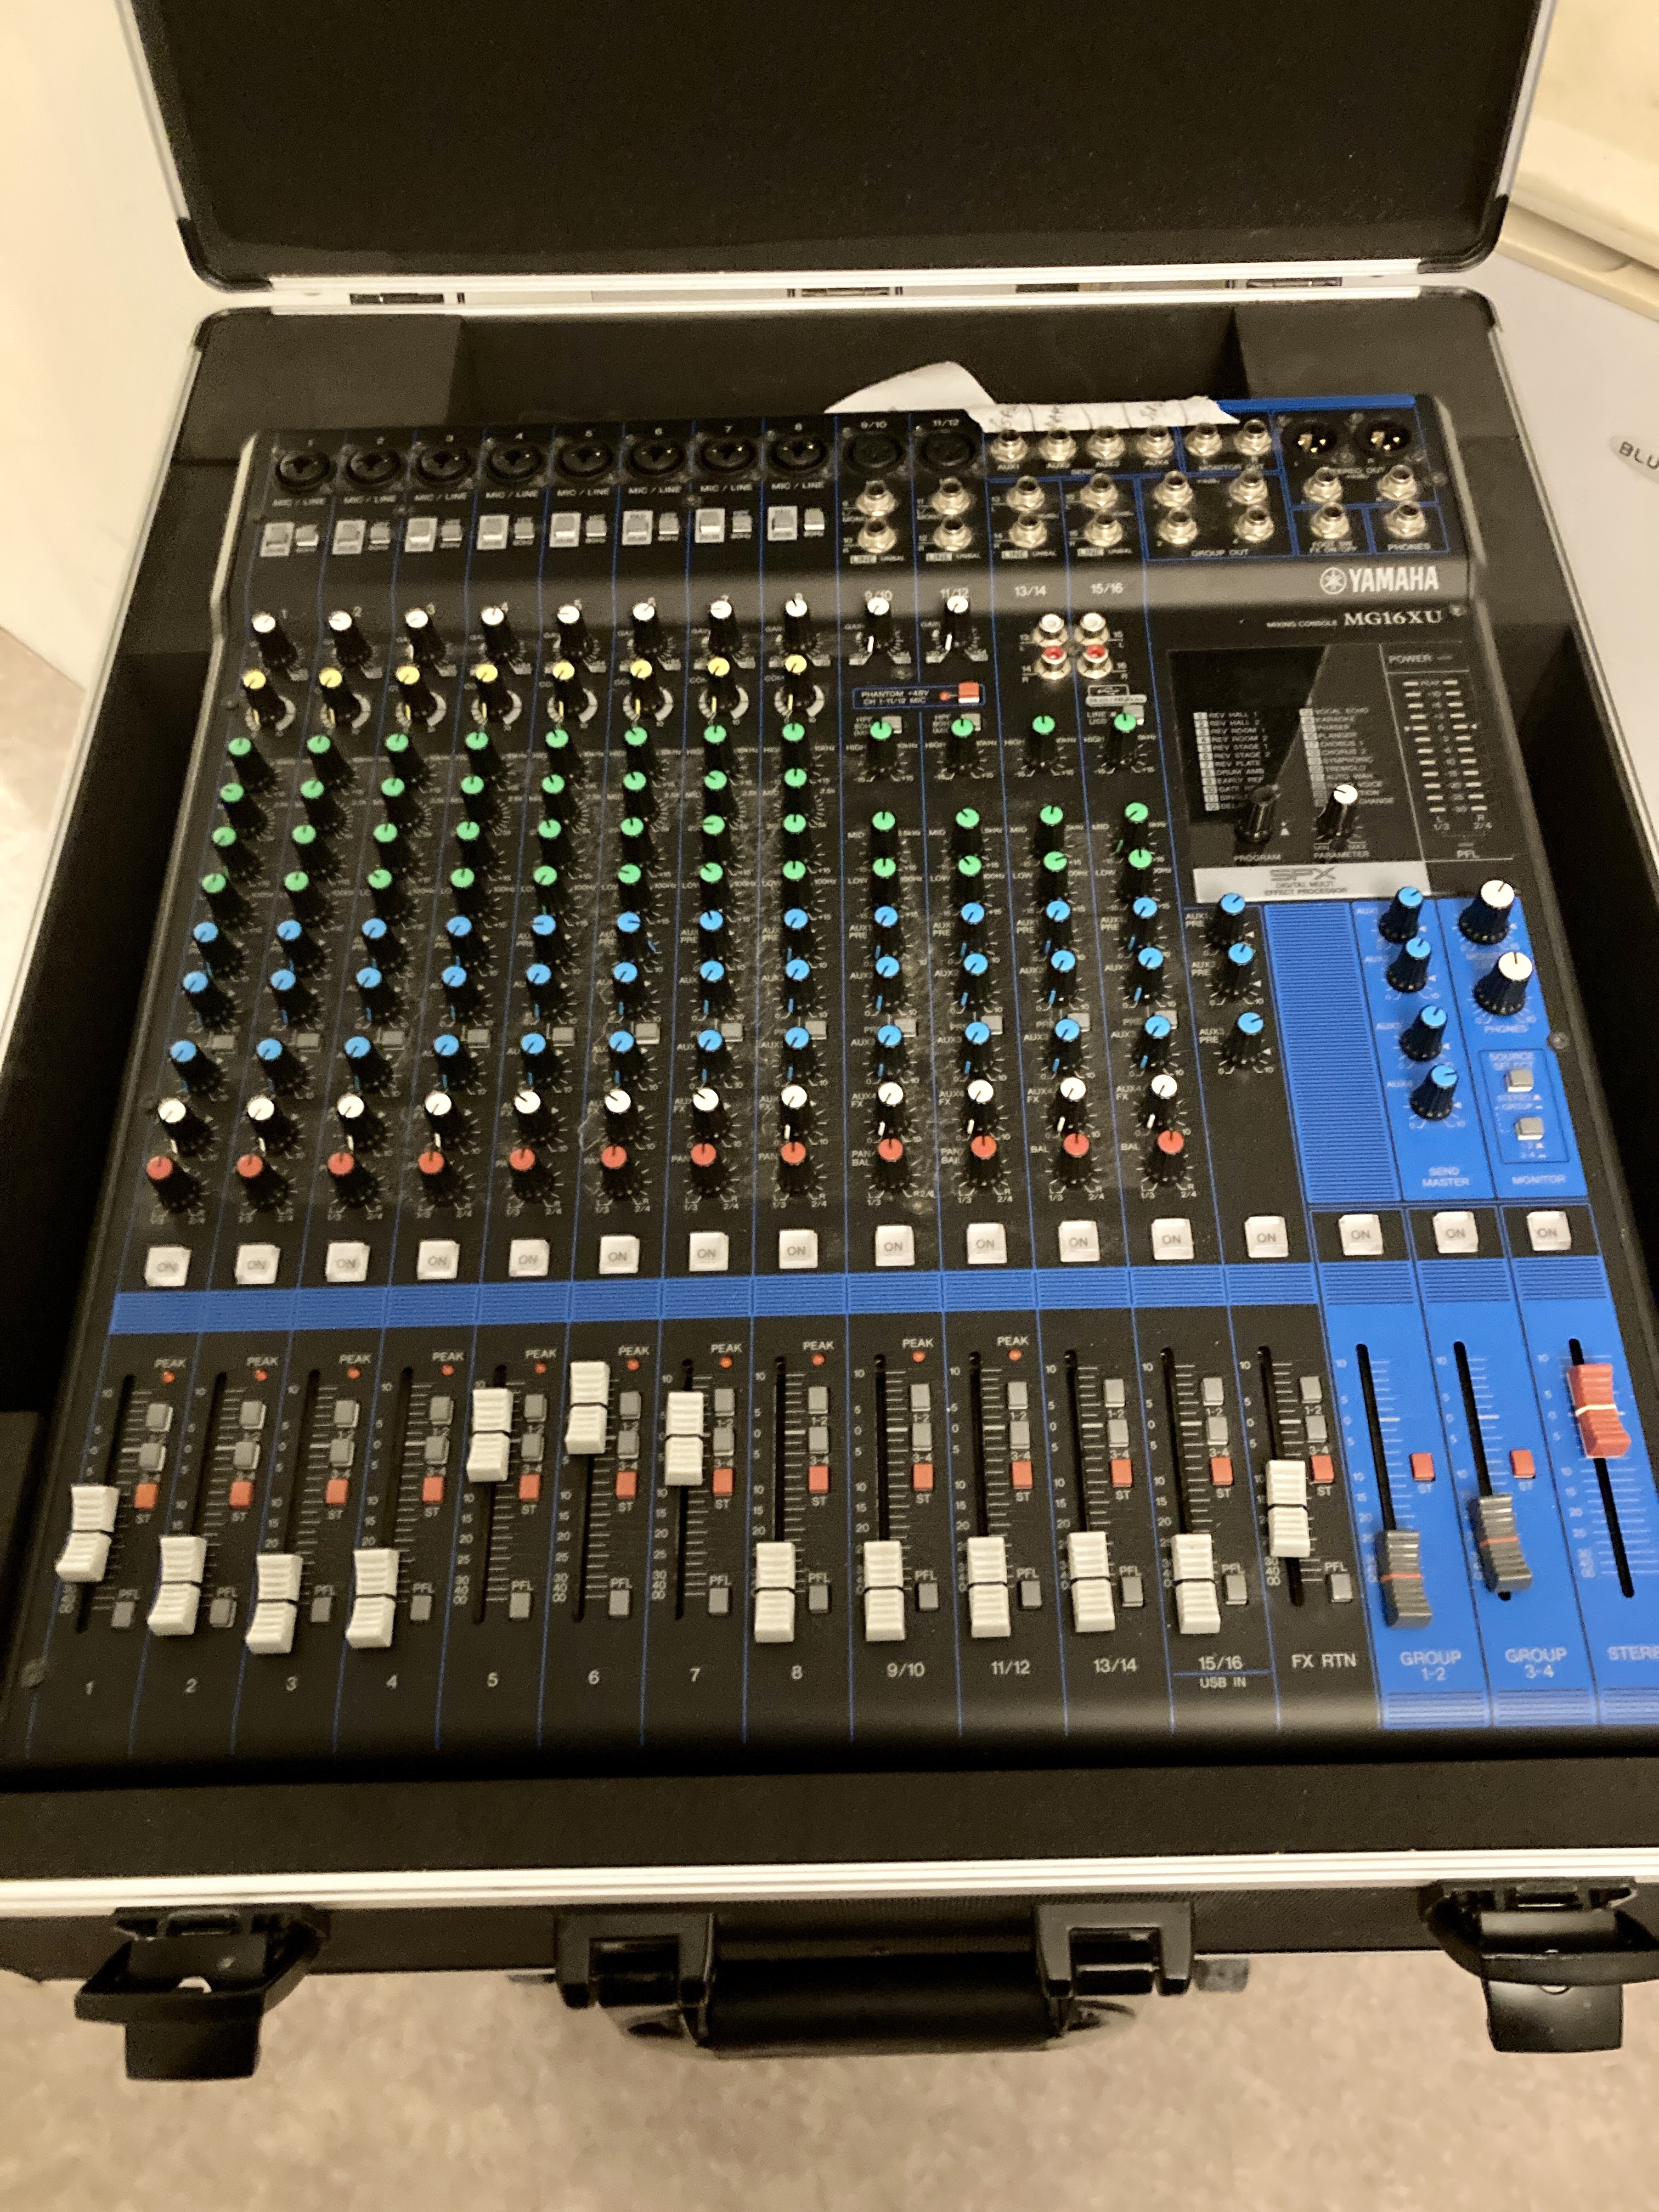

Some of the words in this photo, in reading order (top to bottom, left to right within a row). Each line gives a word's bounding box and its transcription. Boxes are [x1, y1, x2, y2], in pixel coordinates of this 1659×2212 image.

[1349, 566, 1439, 592] YAMAHA
[1015, 585, 1047, 596] 13/14
[1091, 583, 1123, 595] 15/16
[1344, 610, 1442, 625] MG16XU
[1389, 654, 1432, 663] POWER
[1457, 850, 1478, 859] PFL
[1030, 1145, 1049, 1153] BAL
[852, 1159, 870, 1167] BAL
[941, 1156, 960, 1165] BAL
[1429, 1167, 1460, 1176] SEND
[1422, 1177, 1469, 1187] MASTER
[1512, 1175, 1565, 1184] MONITOR
[1256, 1232, 1277, 1243] ON
[1351, 1229, 1371, 1240] ON
[1446, 1228, 1466, 1239] ON
[1537, 1227, 1558, 1238] ON
[976, 1239, 995, 1250] ON
[1069, 1237, 1088, 1248] ON
[1161, 1234, 1182, 1245] ON
[787, 1246, 806, 1257] ON
[884, 1242, 903, 1252] ON
[608, 1251, 628, 1262] ON
[697, 1249, 716, 1259] ON
[336, 1258, 357, 1269] ON
[427, 1256, 448, 1267] ON
[518, 1254, 538, 1265] ON
[157, 1262, 178, 1273] ON
[246, 1260, 267, 1272] ON
[803, 1341, 834, 1351] PEAK
[902, 1339, 934, 1349] PEAK
[997, 1336, 1029, 1346] PEAK
[525, 1348, 557, 1359] PEAK
[618, 1346, 650, 1357] PEAK
[710, 1343, 742, 1354] PEAK
[247, 1356, 279, 1367] PEAK
[339, 1353, 372, 1364] PEAK
[432, 1351, 464, 1363] PEAK
[154, 1358, 187, 1369] PEAK
[1108, 1410, 1125, 1419] 1-2
[1206, 1408, 1223, 1417] 1-2
[1305, 1406, 1321, 1414] 1-2
[623, 1422, 637, 1430] 1-2
[718, 1419, 733, 1427] 1-2
[811, 1417, 827, 1425] 1-2
[1011, 1452, 1031, 1460] 3-4
[1110, 1450, 1129, 1458] 3-4
[1209, 1448, 1229, 1457] 3-4
[810, 1456, 829, 1464] 3-4
[912, 1454, 932, 1462] 3-4
[524, 1464, 542, 1472] 3-4
[618, 1462, 636, 1471] 3-4
[714, 1459, 733, 1468] 3-4
[1418, 1483, 1433, 1493] ST
[1518, 1481, 1533, 1491] ST
[1016, 1492, 1030, 1501] ST
[1115, 1491, 1130, 1499] ST
[1216, 1489, 1231, 1498] ST
[1317, 1487, 1331, 1496] ST
[715, 1499, 729, 1509] ST
[811, 1497, 826, 1506] ST
[916, 1495, 930, 1504] ST
[425, 1507, 439, 1516] ST
[521, 1505, 536, 1515] ST
[618, 1502, 633, 1512] ST
[136, 1514, 150, 1523] ST
[231, 1513, 246, 1522] ST
[329, 1510, 343, 1520] ST
[1119, 1566, 1142, 1576] PFL
[1222, 1564, 1243, 1573] PFL
[1325, 1562, 1347, 1572] PFL
[808, 1573, 830, 1583] PFL
[915, 1571, 936, 1581] PFL
[1017, 1568, 1039, 1578] PFL
[511, 1581, 533, 1591] PFL
[611, 1578, 631, 1588] PFL
[710, 1576, 731, 1586] PFL
[413, 1583, 434, 1593] PFL
[1400, 1651, 1462, 1666] GROUP
[1504, 1647, 1567, 1663] GROUP
[1093, 1657, 1137, 1673] 13/14
[1198, 1655, 1243, 1671] 15/16
[1292, 1654, 1314, 1668] FX
[1322, 1653, 1357, 1668] RTN
[791, 1665, 803, 1680] 8
[887, 1662, 925, 1678] 9/10
[991, 1660, 1030, 1676] 11/12
[1525, 1663, 1555, 1679] 3-4
[589, 1670, 600, 1684] 6
[690, 1668, 701, 1682] 7
[1422, 1667, 1446, 1681] 1-2
[286, 1675, 298, 1691] 3
[386, 1674, 398, 1689] 4
[487, 1672, 498, 1687] 5
[1200, 1676, 1227, 1689] USB
[1233, 1675, 1246, 1688] IN
[84, 1681, 94, 1695] 1
[185, 1678, 199, 1694] 2
